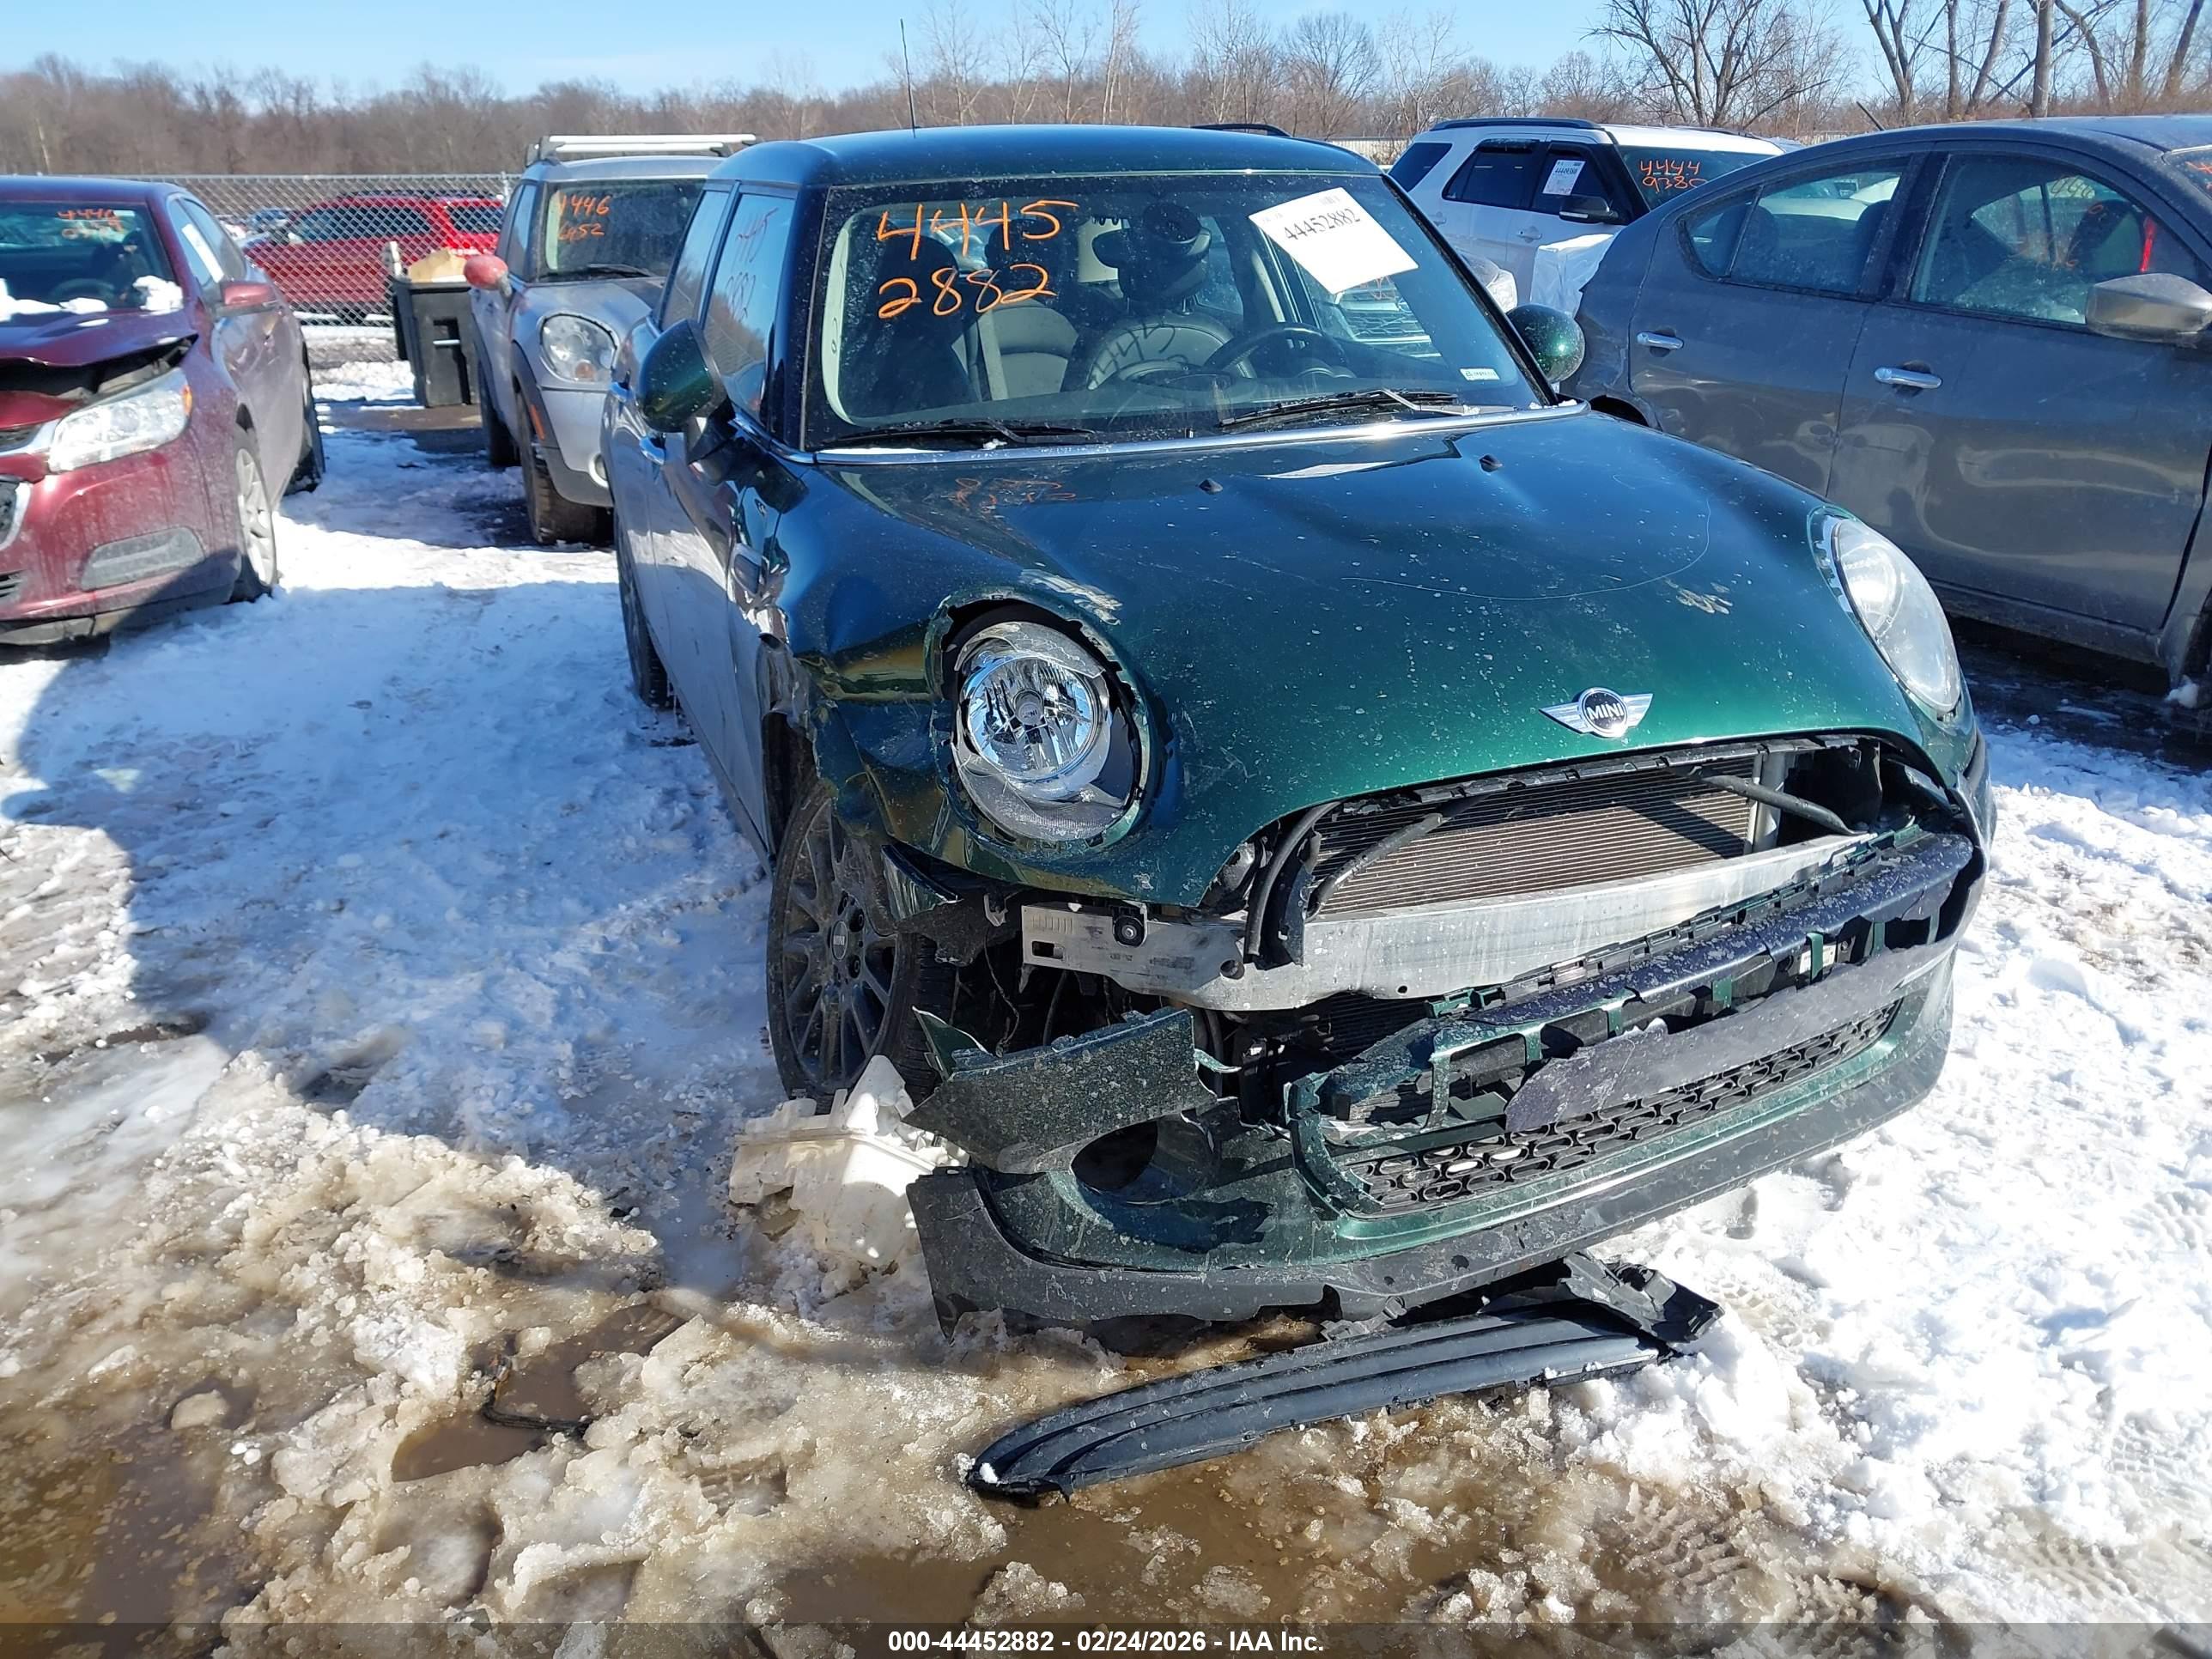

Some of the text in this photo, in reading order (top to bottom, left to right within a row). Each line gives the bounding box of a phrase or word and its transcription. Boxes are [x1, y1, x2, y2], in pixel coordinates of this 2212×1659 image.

[1640, 159, 1701, 177] 4444
[1642, 175, 1708, 194] 9380
[877, 199, 1079, 261] 4445
[1283, 207, 1362, 240] 44452882
[878, 263, 1058, 319] 2882
[1586, 702, 1625, 720] MINI
